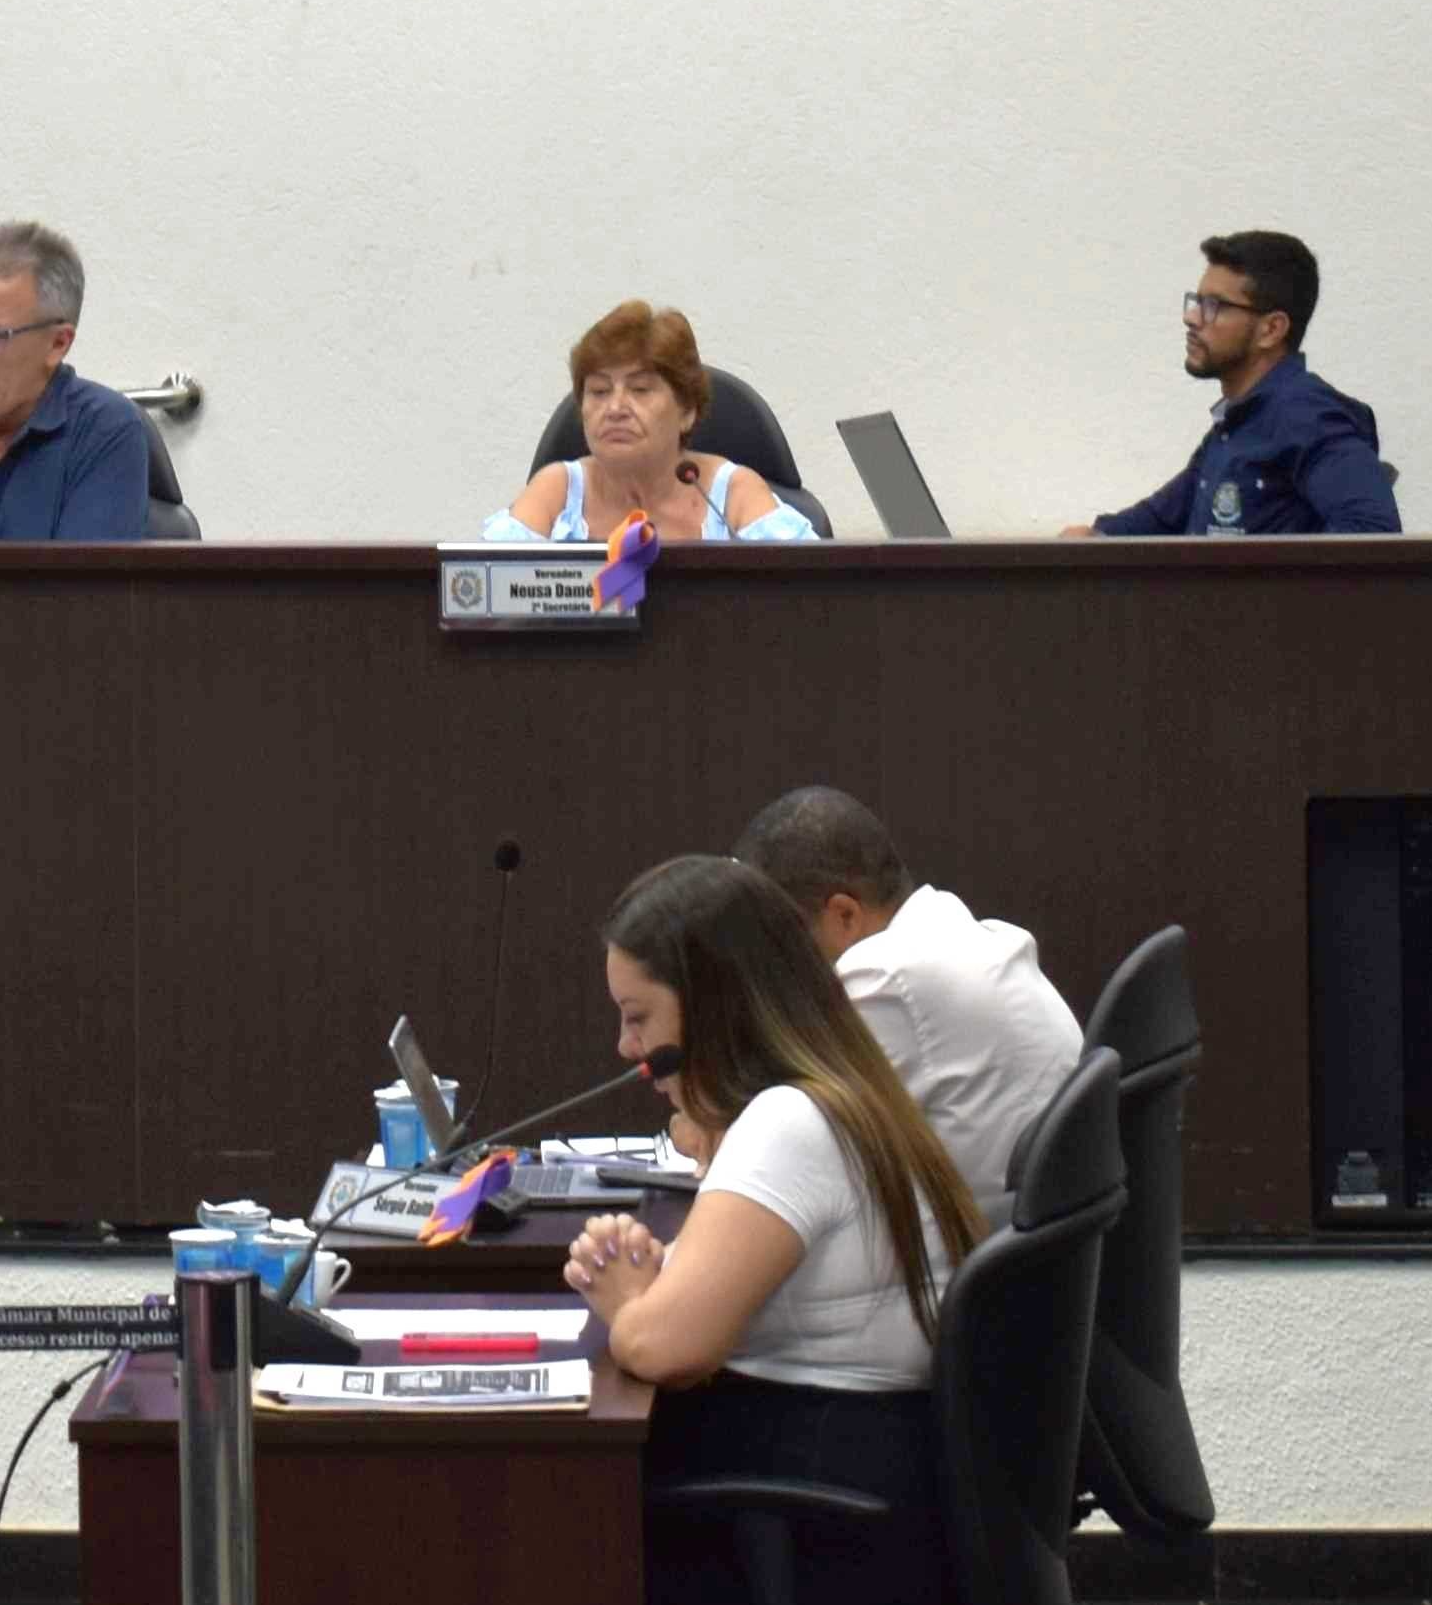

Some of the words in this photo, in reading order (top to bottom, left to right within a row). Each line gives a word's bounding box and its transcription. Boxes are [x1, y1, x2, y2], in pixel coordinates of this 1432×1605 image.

[509, 582, 552, 599] Neusa
[555, 581, 593, 599] Damé
[57, 1304, 145, 1326] Municipal
[149, 1305, 171, 1322] de
[50, 1326, 117, 1347] restrito
